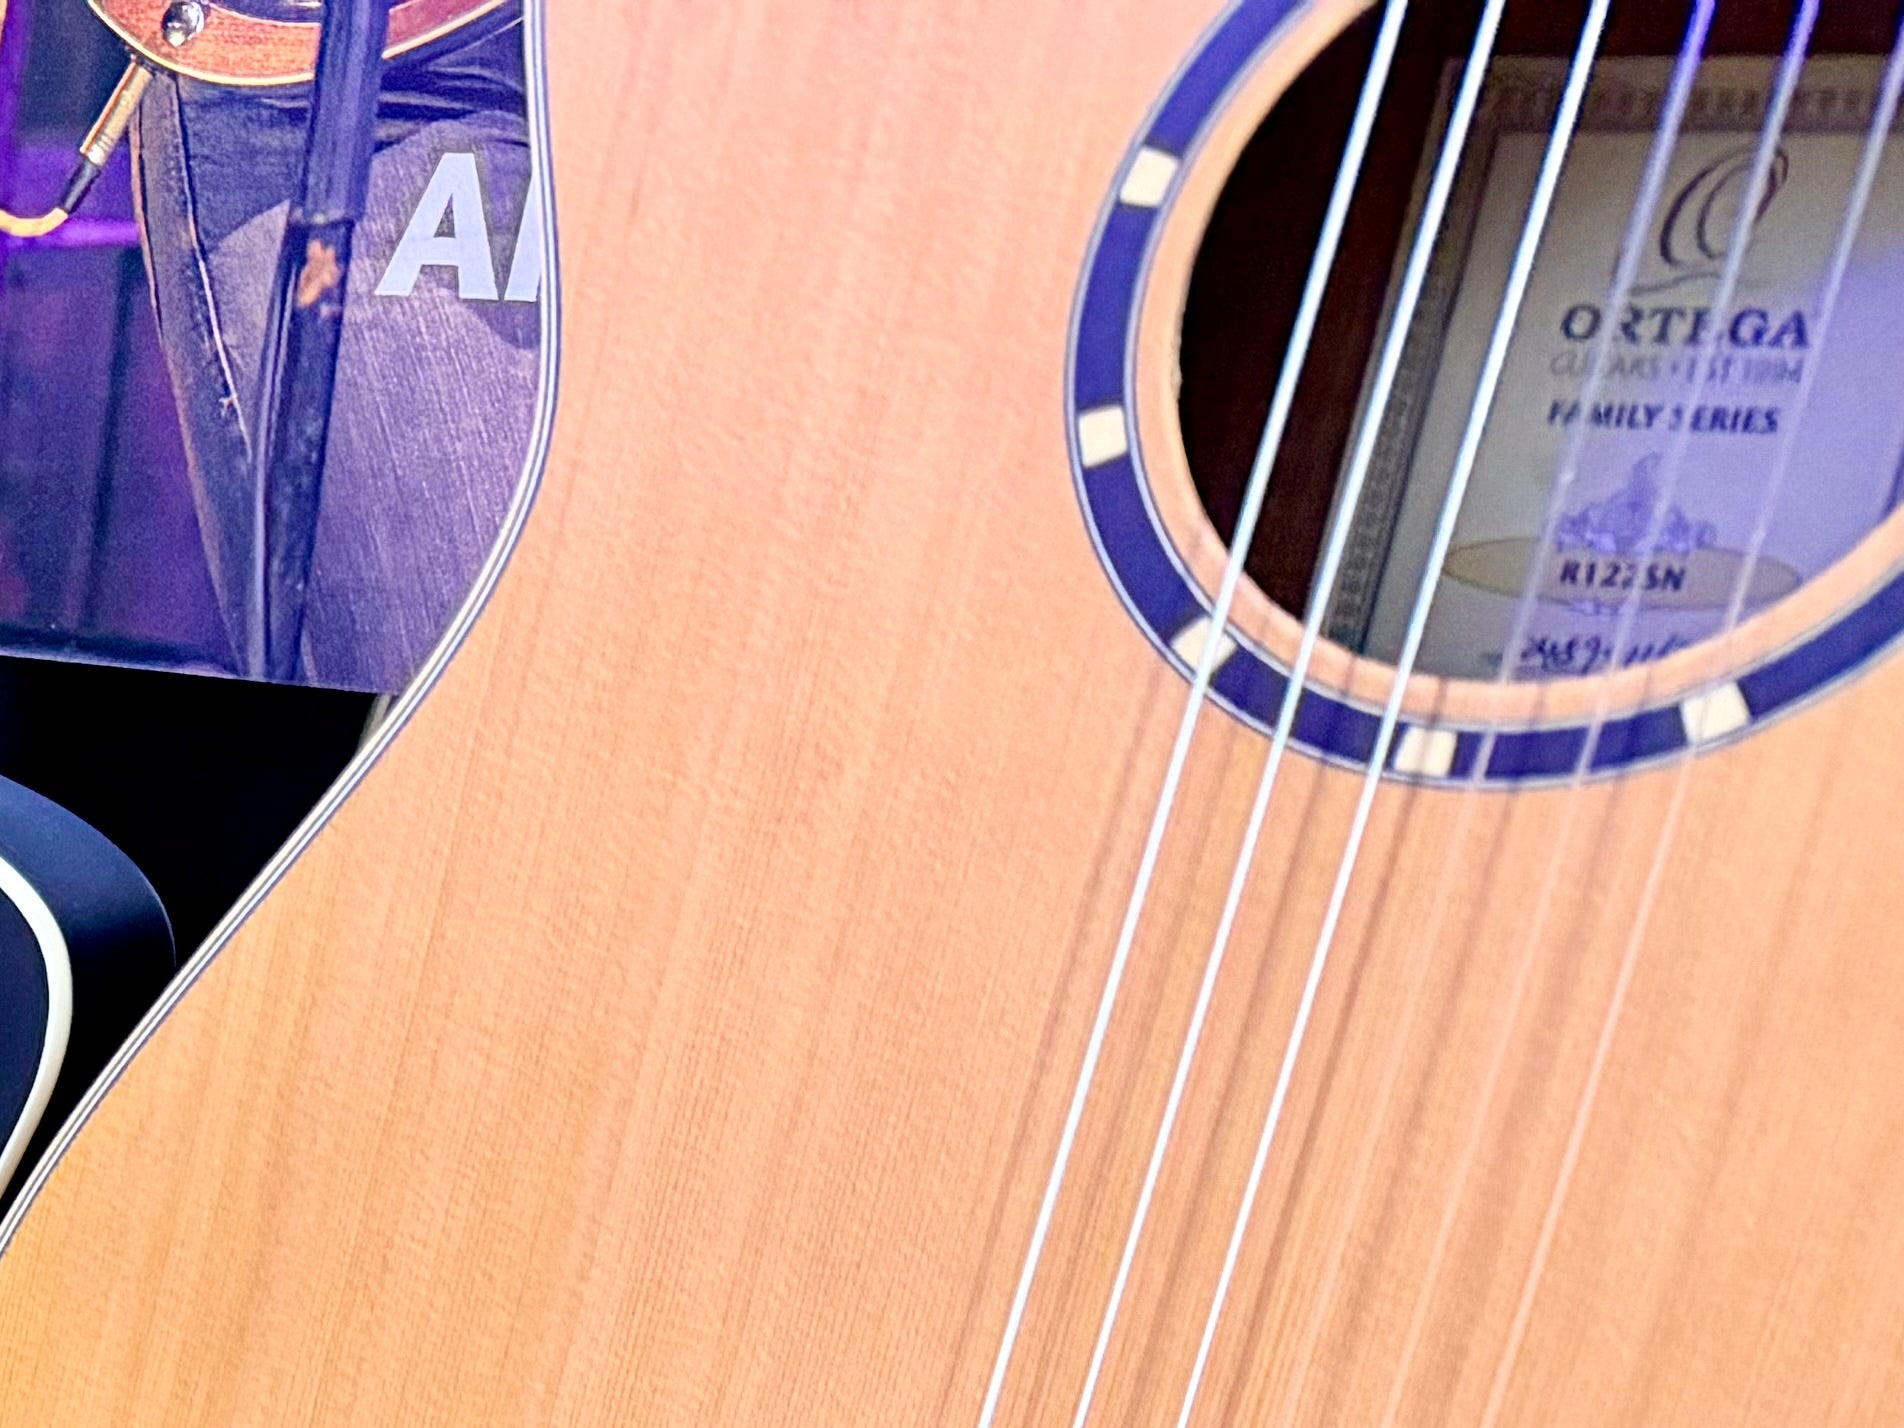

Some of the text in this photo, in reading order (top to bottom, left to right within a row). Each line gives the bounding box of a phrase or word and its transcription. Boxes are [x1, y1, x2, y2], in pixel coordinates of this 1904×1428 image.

[1561, 301, 1812, 350] ORTEGA
[1549, 399, 1782, 436] FAMILY SERIES
